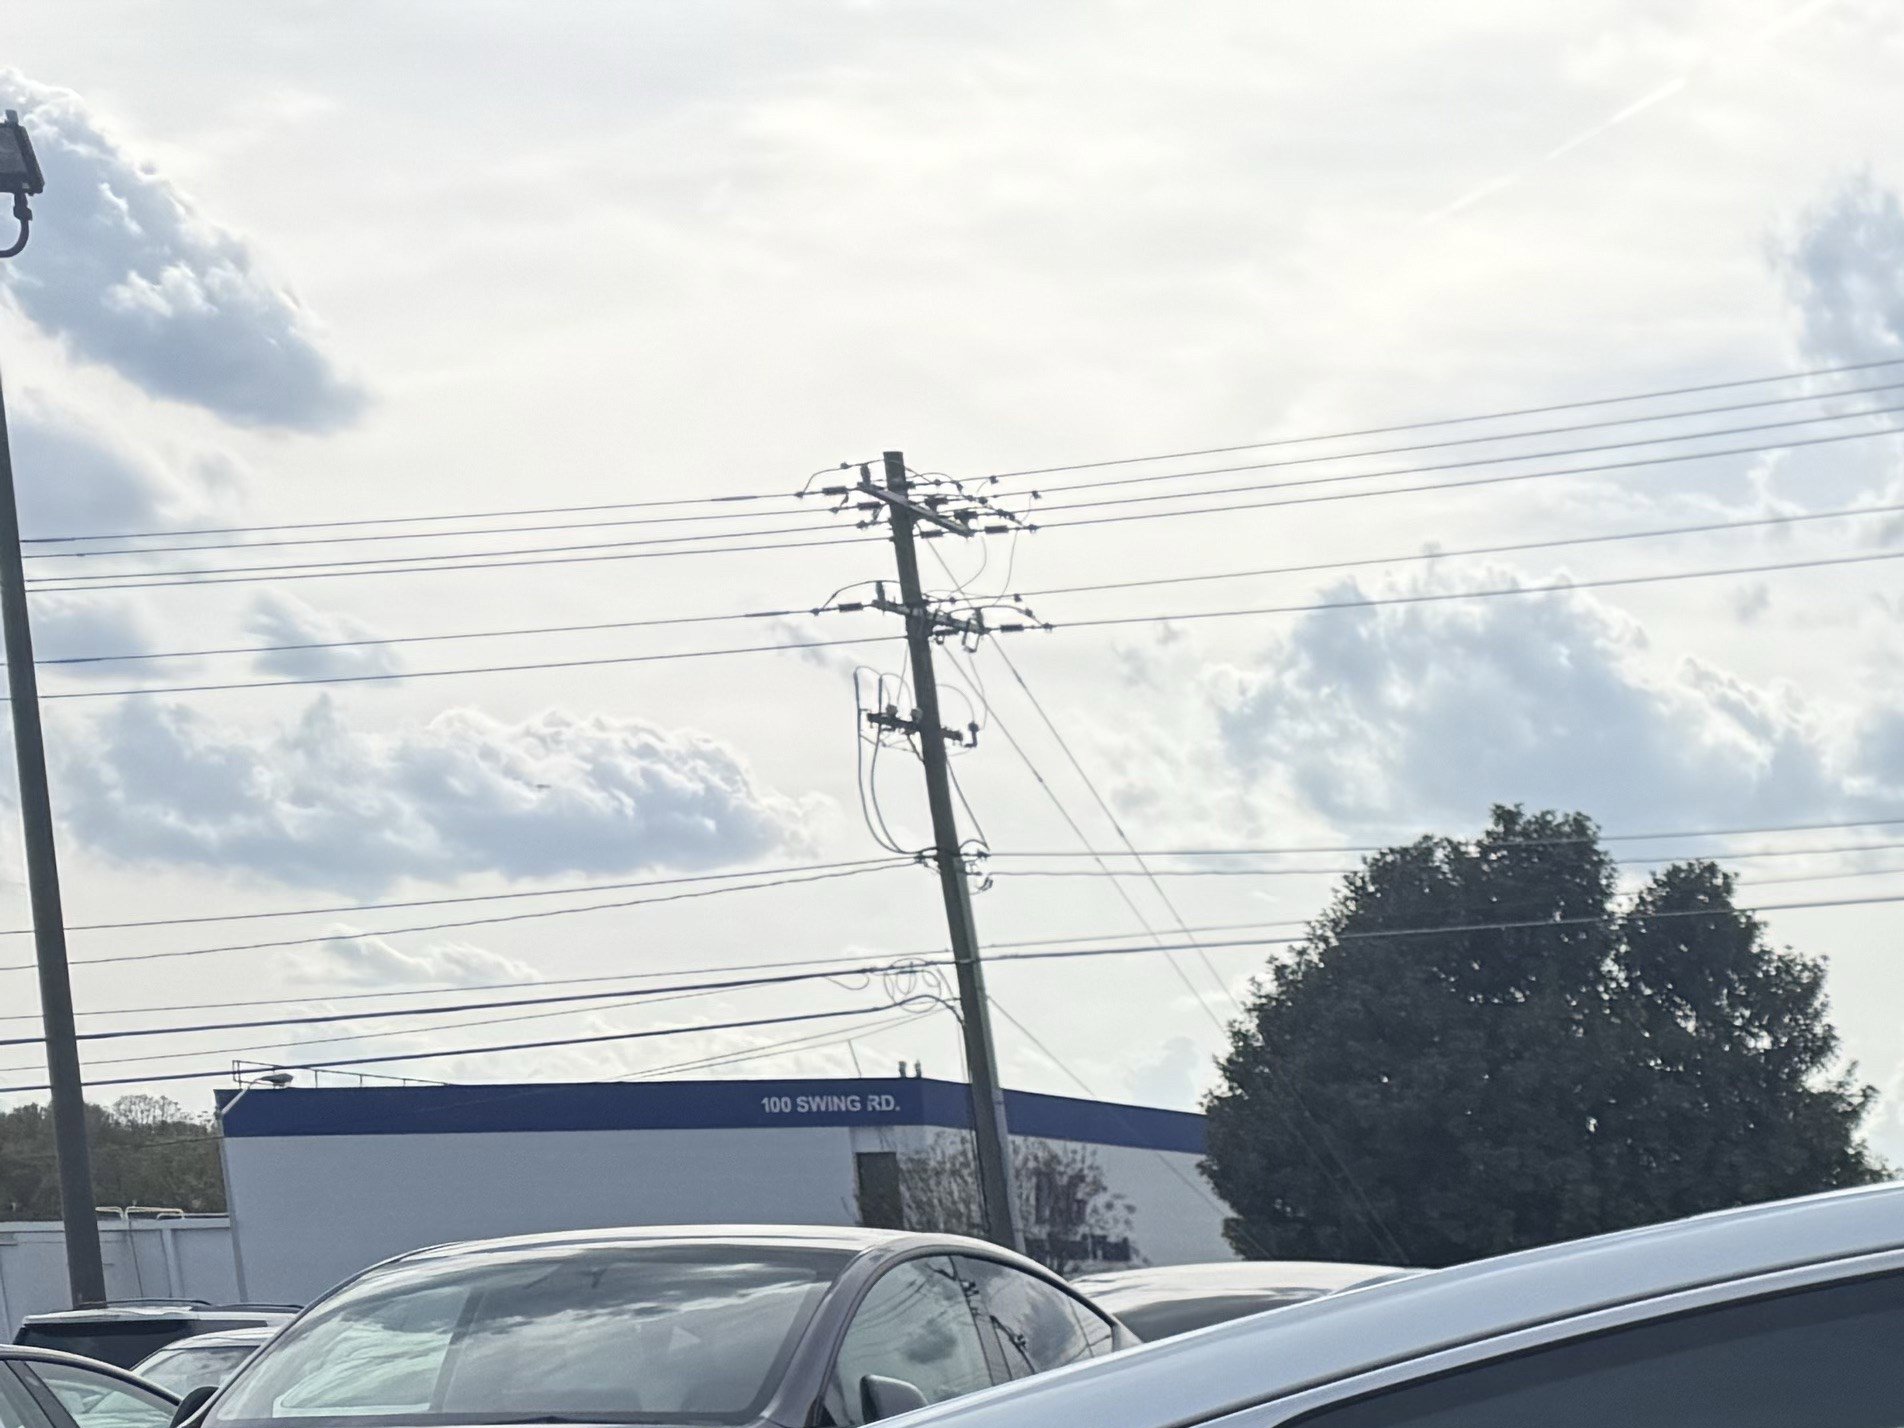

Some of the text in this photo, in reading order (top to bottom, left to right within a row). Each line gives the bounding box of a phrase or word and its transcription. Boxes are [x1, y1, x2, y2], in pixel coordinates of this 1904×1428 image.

[760, 1094, 901, 1113] 100 SWING RD.
